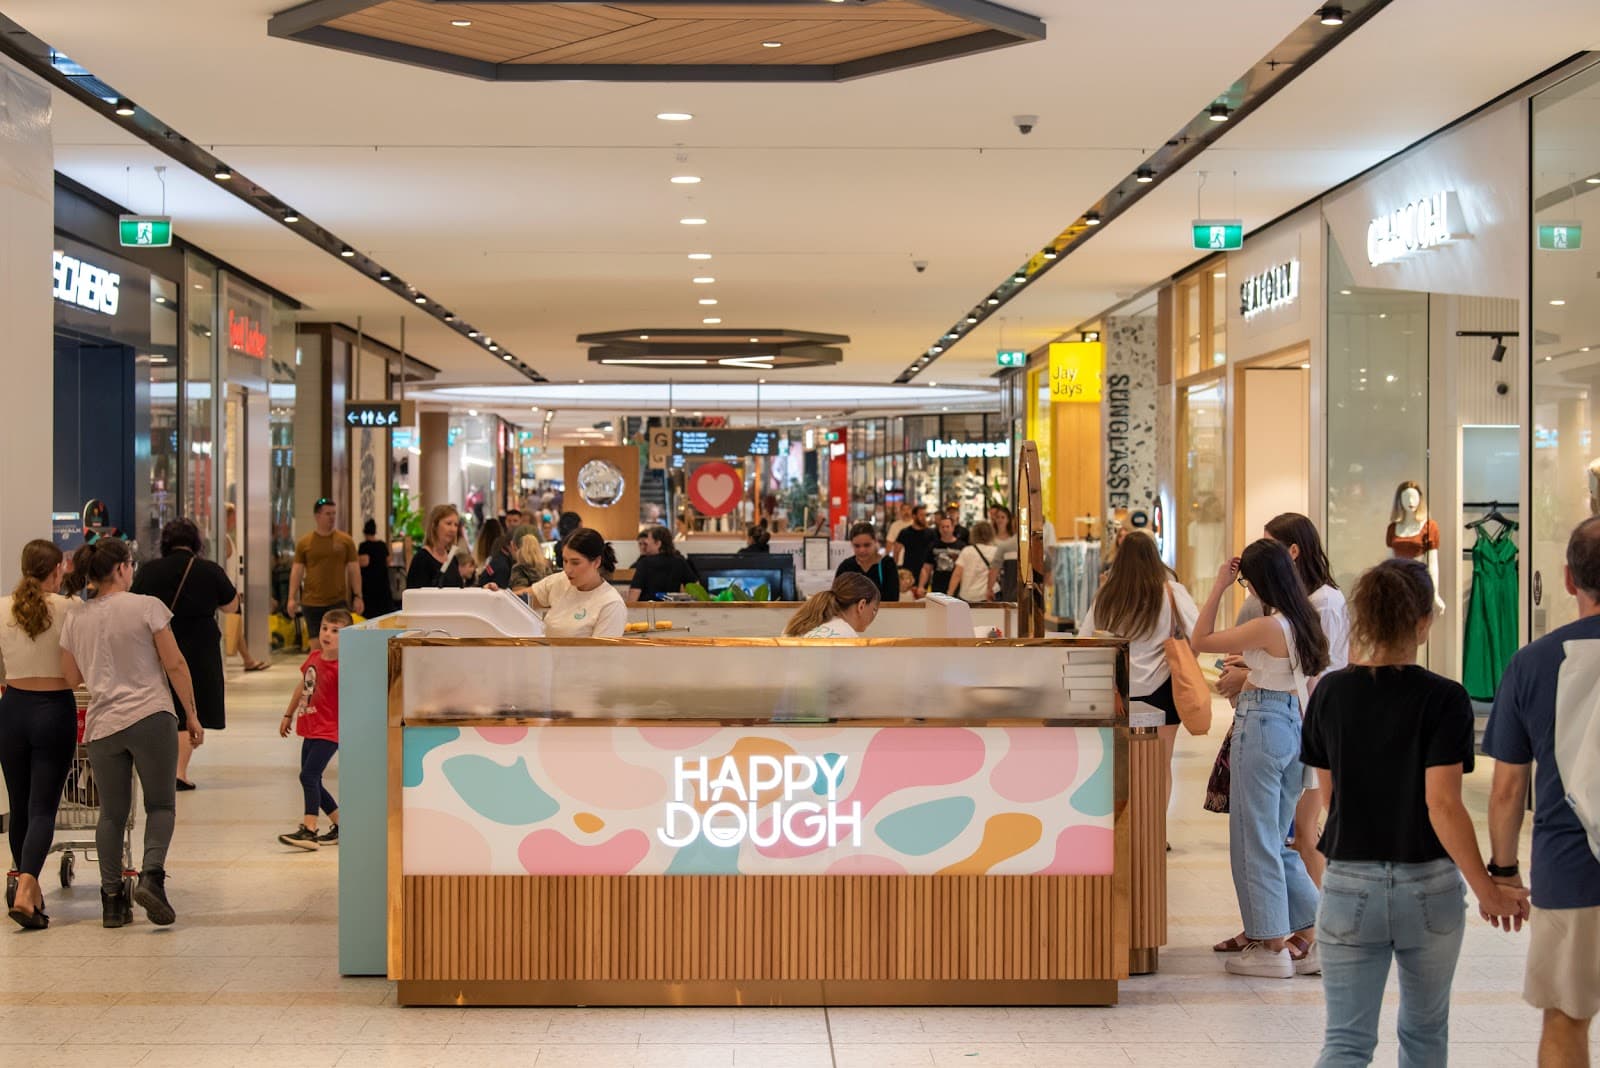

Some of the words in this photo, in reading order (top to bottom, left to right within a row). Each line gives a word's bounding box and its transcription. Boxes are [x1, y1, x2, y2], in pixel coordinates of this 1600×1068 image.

[1052, 365, 1077, 382] Jay
[1052, 382, 1083, 398] Jays
[654, 432, 668, 448] G
[926, 438, 1011, 458] Universal
[1107, 374, 1130, 509] SUNGLASSE
[674, 754, 849, 803] HAPPY
[657, 801, 863, 849] DOUGH
